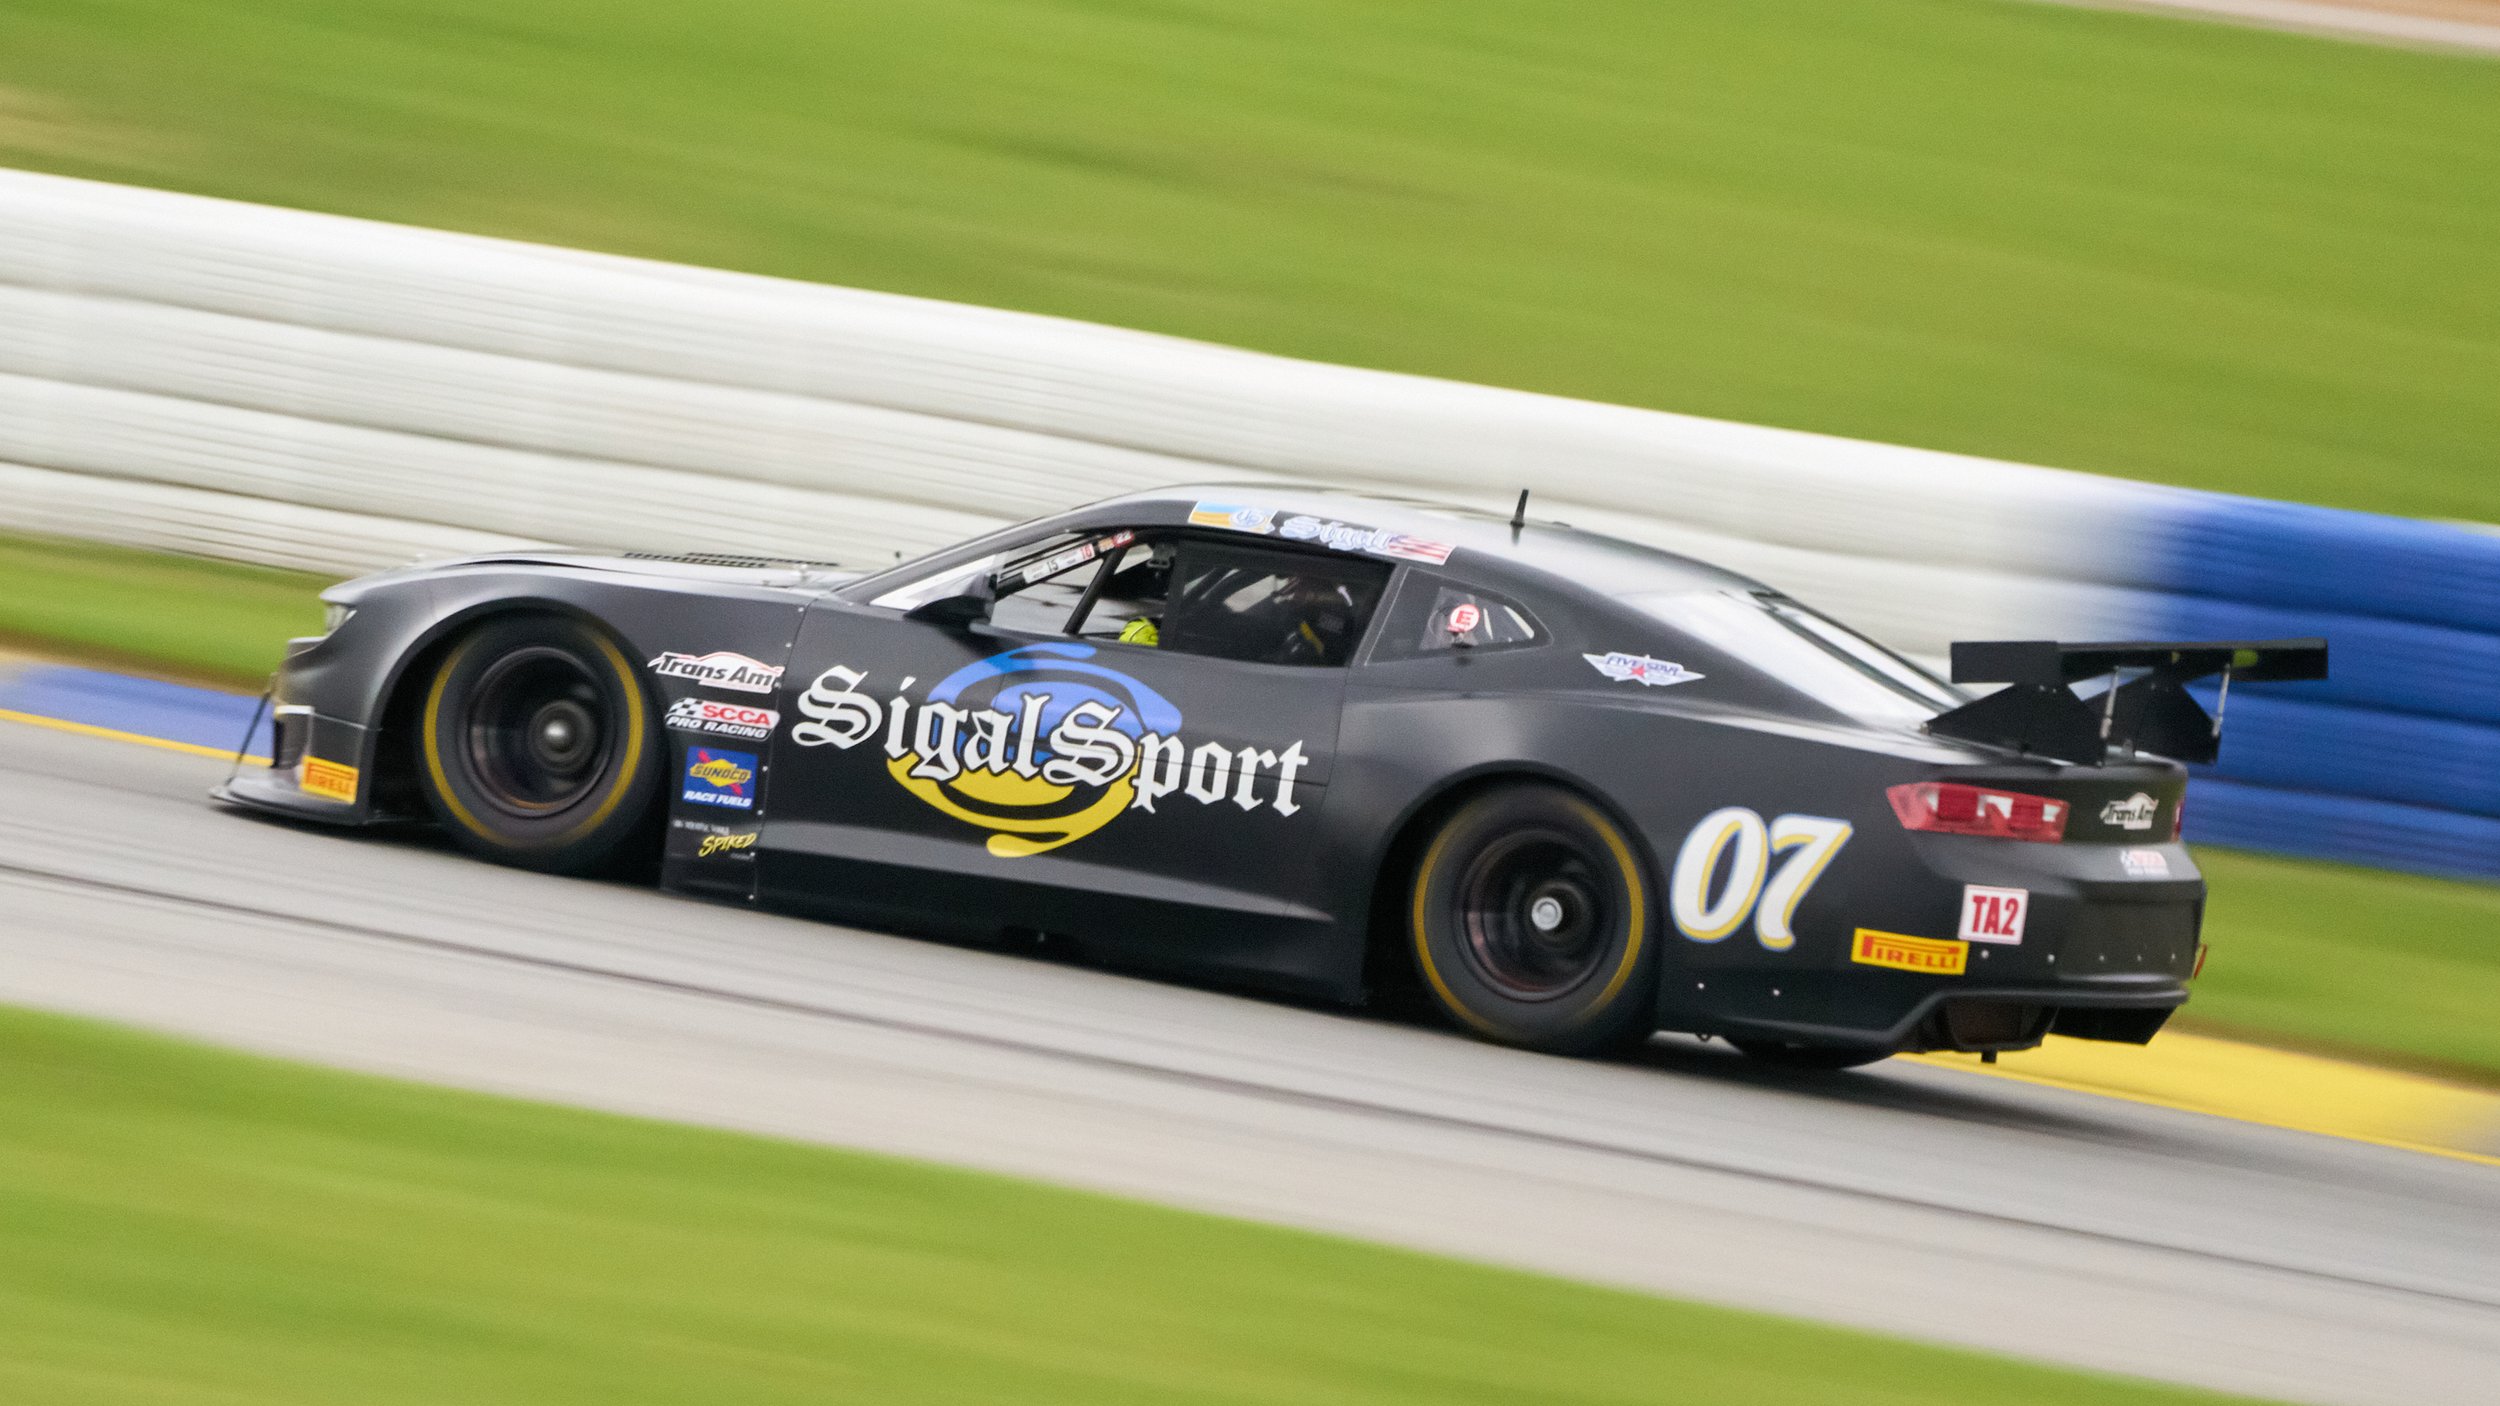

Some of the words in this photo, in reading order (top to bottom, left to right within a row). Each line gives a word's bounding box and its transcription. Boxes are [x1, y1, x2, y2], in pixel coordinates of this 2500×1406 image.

[1455, 610, 1474, 626] E
[660, 655, 728, 680] Trans
[728, 666, 773, 686] Am
[665, 715, 703, 730] PRO
[703, 721, 768, 739] RACING
[702, 704, 770, 726] SCCA
[792, 664, 1309, 817] SigalSport
[694, 764, 749, 783] SUNOCO
[683, 789, 718, 804] RACE
[715, 793, 753, 808] FUELS
[698, 832, 758, 858] SPIKED
[1670, 806, 1854, 952] 07
[1971, 895, 2020, 936] TA2
[1860, 934, 1962, 969] PIRELLI
